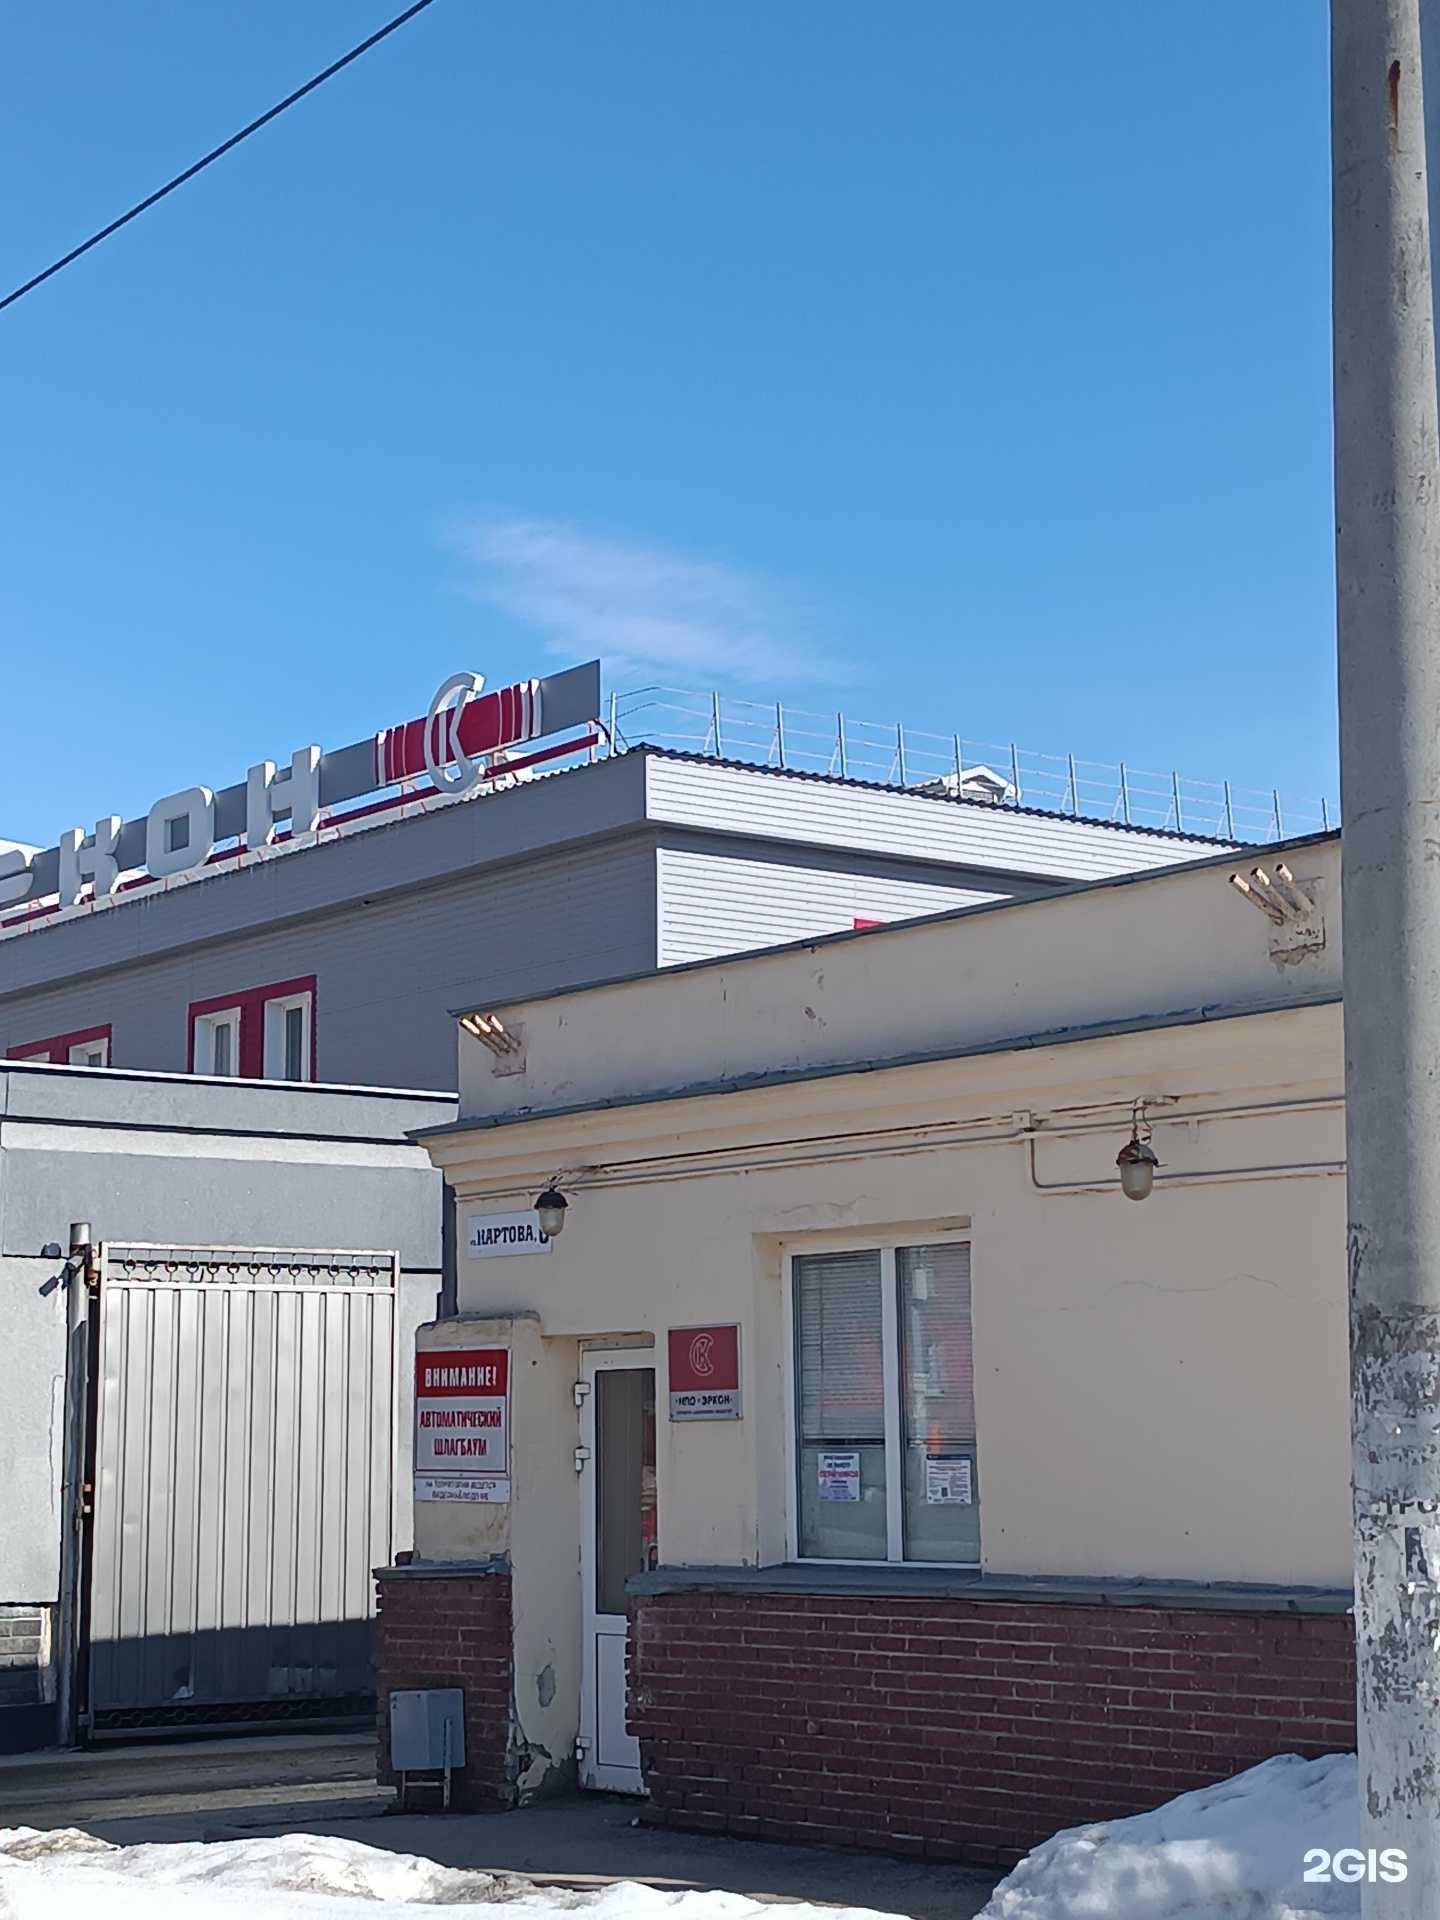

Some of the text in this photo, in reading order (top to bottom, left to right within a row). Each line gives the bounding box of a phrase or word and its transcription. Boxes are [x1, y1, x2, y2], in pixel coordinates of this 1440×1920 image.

[425, 1366, 497, 1388] ВНИМАНИЕ!
[419, 1406, 502, 1428] АВТОМАТИЧЕСКИЙ
[434, 1438, 487, 1456] ШЛАГБАУМ
